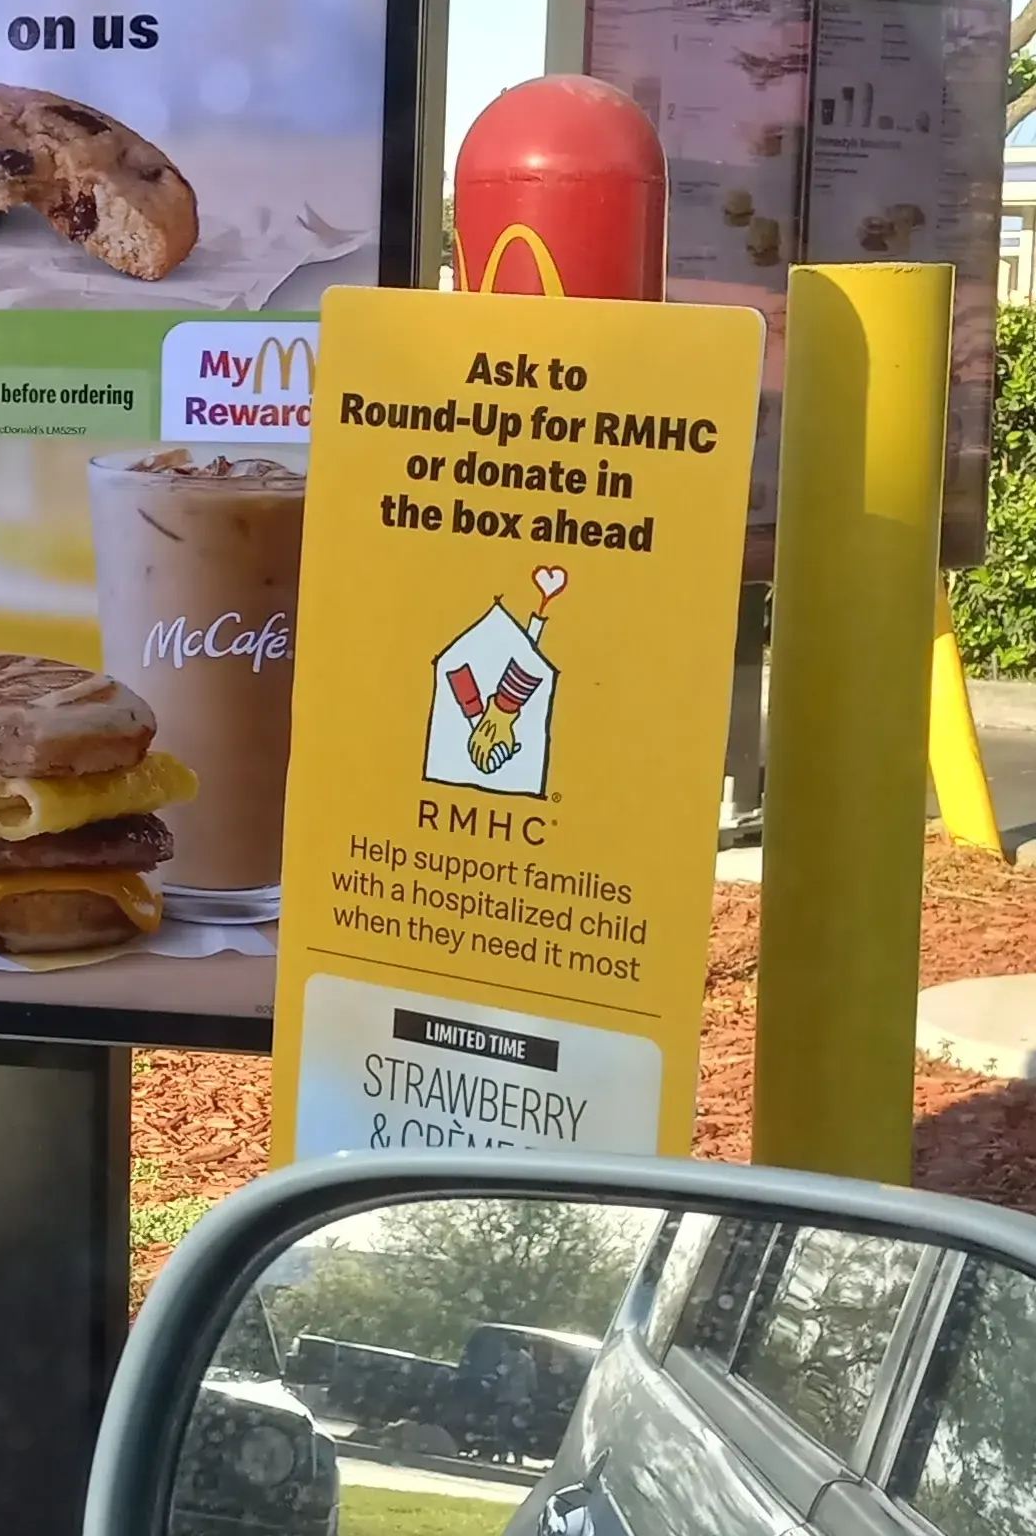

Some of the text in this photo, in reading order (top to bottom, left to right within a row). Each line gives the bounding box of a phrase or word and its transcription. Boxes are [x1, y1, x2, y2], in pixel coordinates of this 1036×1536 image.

[7, 16, 76, 50] on
[92, 14, 159, 50] us
[1, 384, 56, 405] before
[59, 385, 134, 411] ordering
[466, 352, 588, 392] Ask to
[185, 396, 312, 426] Reward
[340, 393, 718, 454] Round-Up for RMHC
[406, 451, 634, 499] or donate in
[381, 494, 655, 553] the box ahead
[141, 612, 289, 673] McCafé
[350, 835, 633, 905] Help support families
[332, 871, 648, 945] with a hospitalized child
[333, 905, 641, 983] when they need it most
[425, 1020, 526, 1060] LIMITED TIME
[363, 1053, 588, 1142] STRAWBERRY
